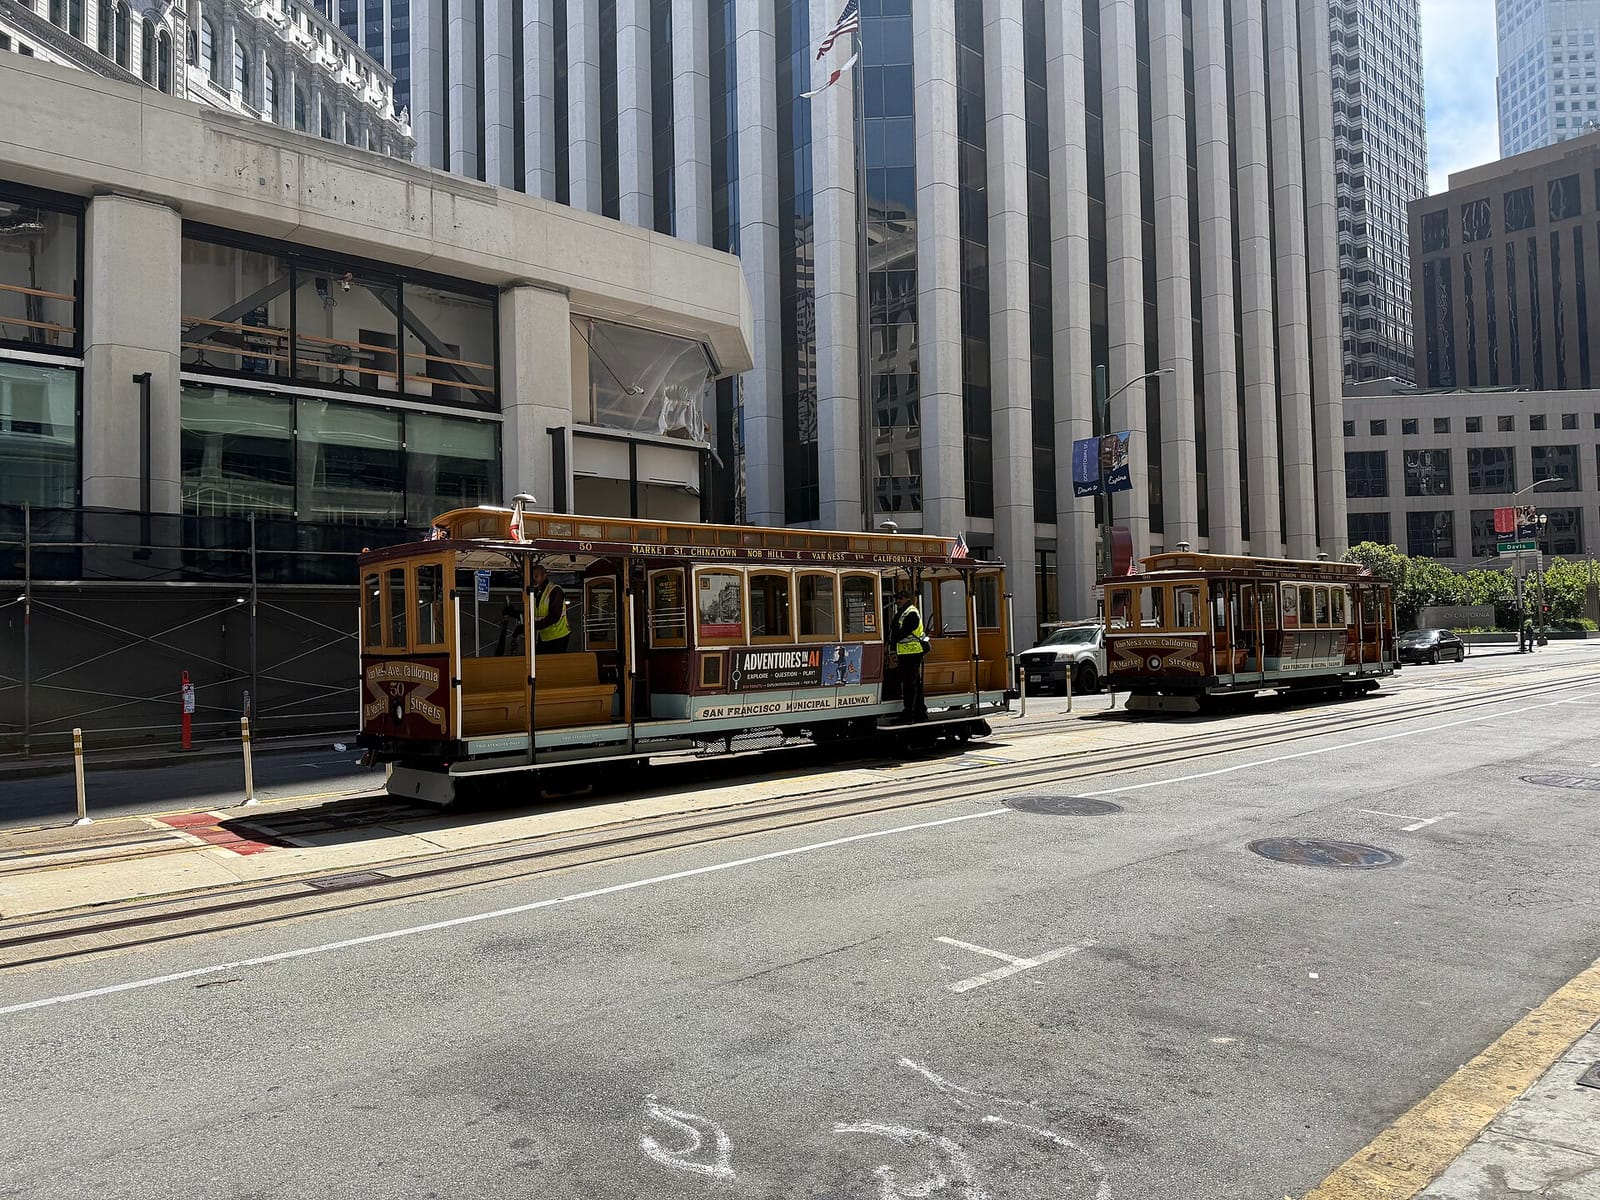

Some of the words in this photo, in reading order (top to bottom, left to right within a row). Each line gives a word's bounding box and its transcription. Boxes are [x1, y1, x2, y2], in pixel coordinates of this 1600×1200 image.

[578, 543, 593, 552] 50
[632, 545, 668, 555] MARKET
[674, 547, 687, 556] ST.
[690, 548, 737, 558] CHINATOWN
[747, 550, 763, 558] NOB
[767, 550, 785, 559] HILL
[811, 552, 827, 560] VAN
[828, 552, 845, 561] NESS
[873, 555, 912, 563] CALIFORNIA
[1126, 639, 1142, 647] Ness
[1161, 639, 1197, 649] California
[744, 651, 801, 671] ADVENTURES
[801, 651, 809, 662] IN
[809, 650, 820, 667] AI
[1118, 658, 1142, 668] Market
[1168, 658, 1201, 669] Streets
[403, 665, 438, 683] California
[747, 672, 768, 680] EXPLORE
[774, 671, 798, 679] QUESTION
[390, 682, 405, 696] 50
[410, 697, 441, 719] Streets
[702, 709, 724, 718] SAN
[726, 703, 781, 717] FRANCISCO
[786, 699, 831, 711] MUNICIPAL
[837, 696, 870, 707] RAILWAY
